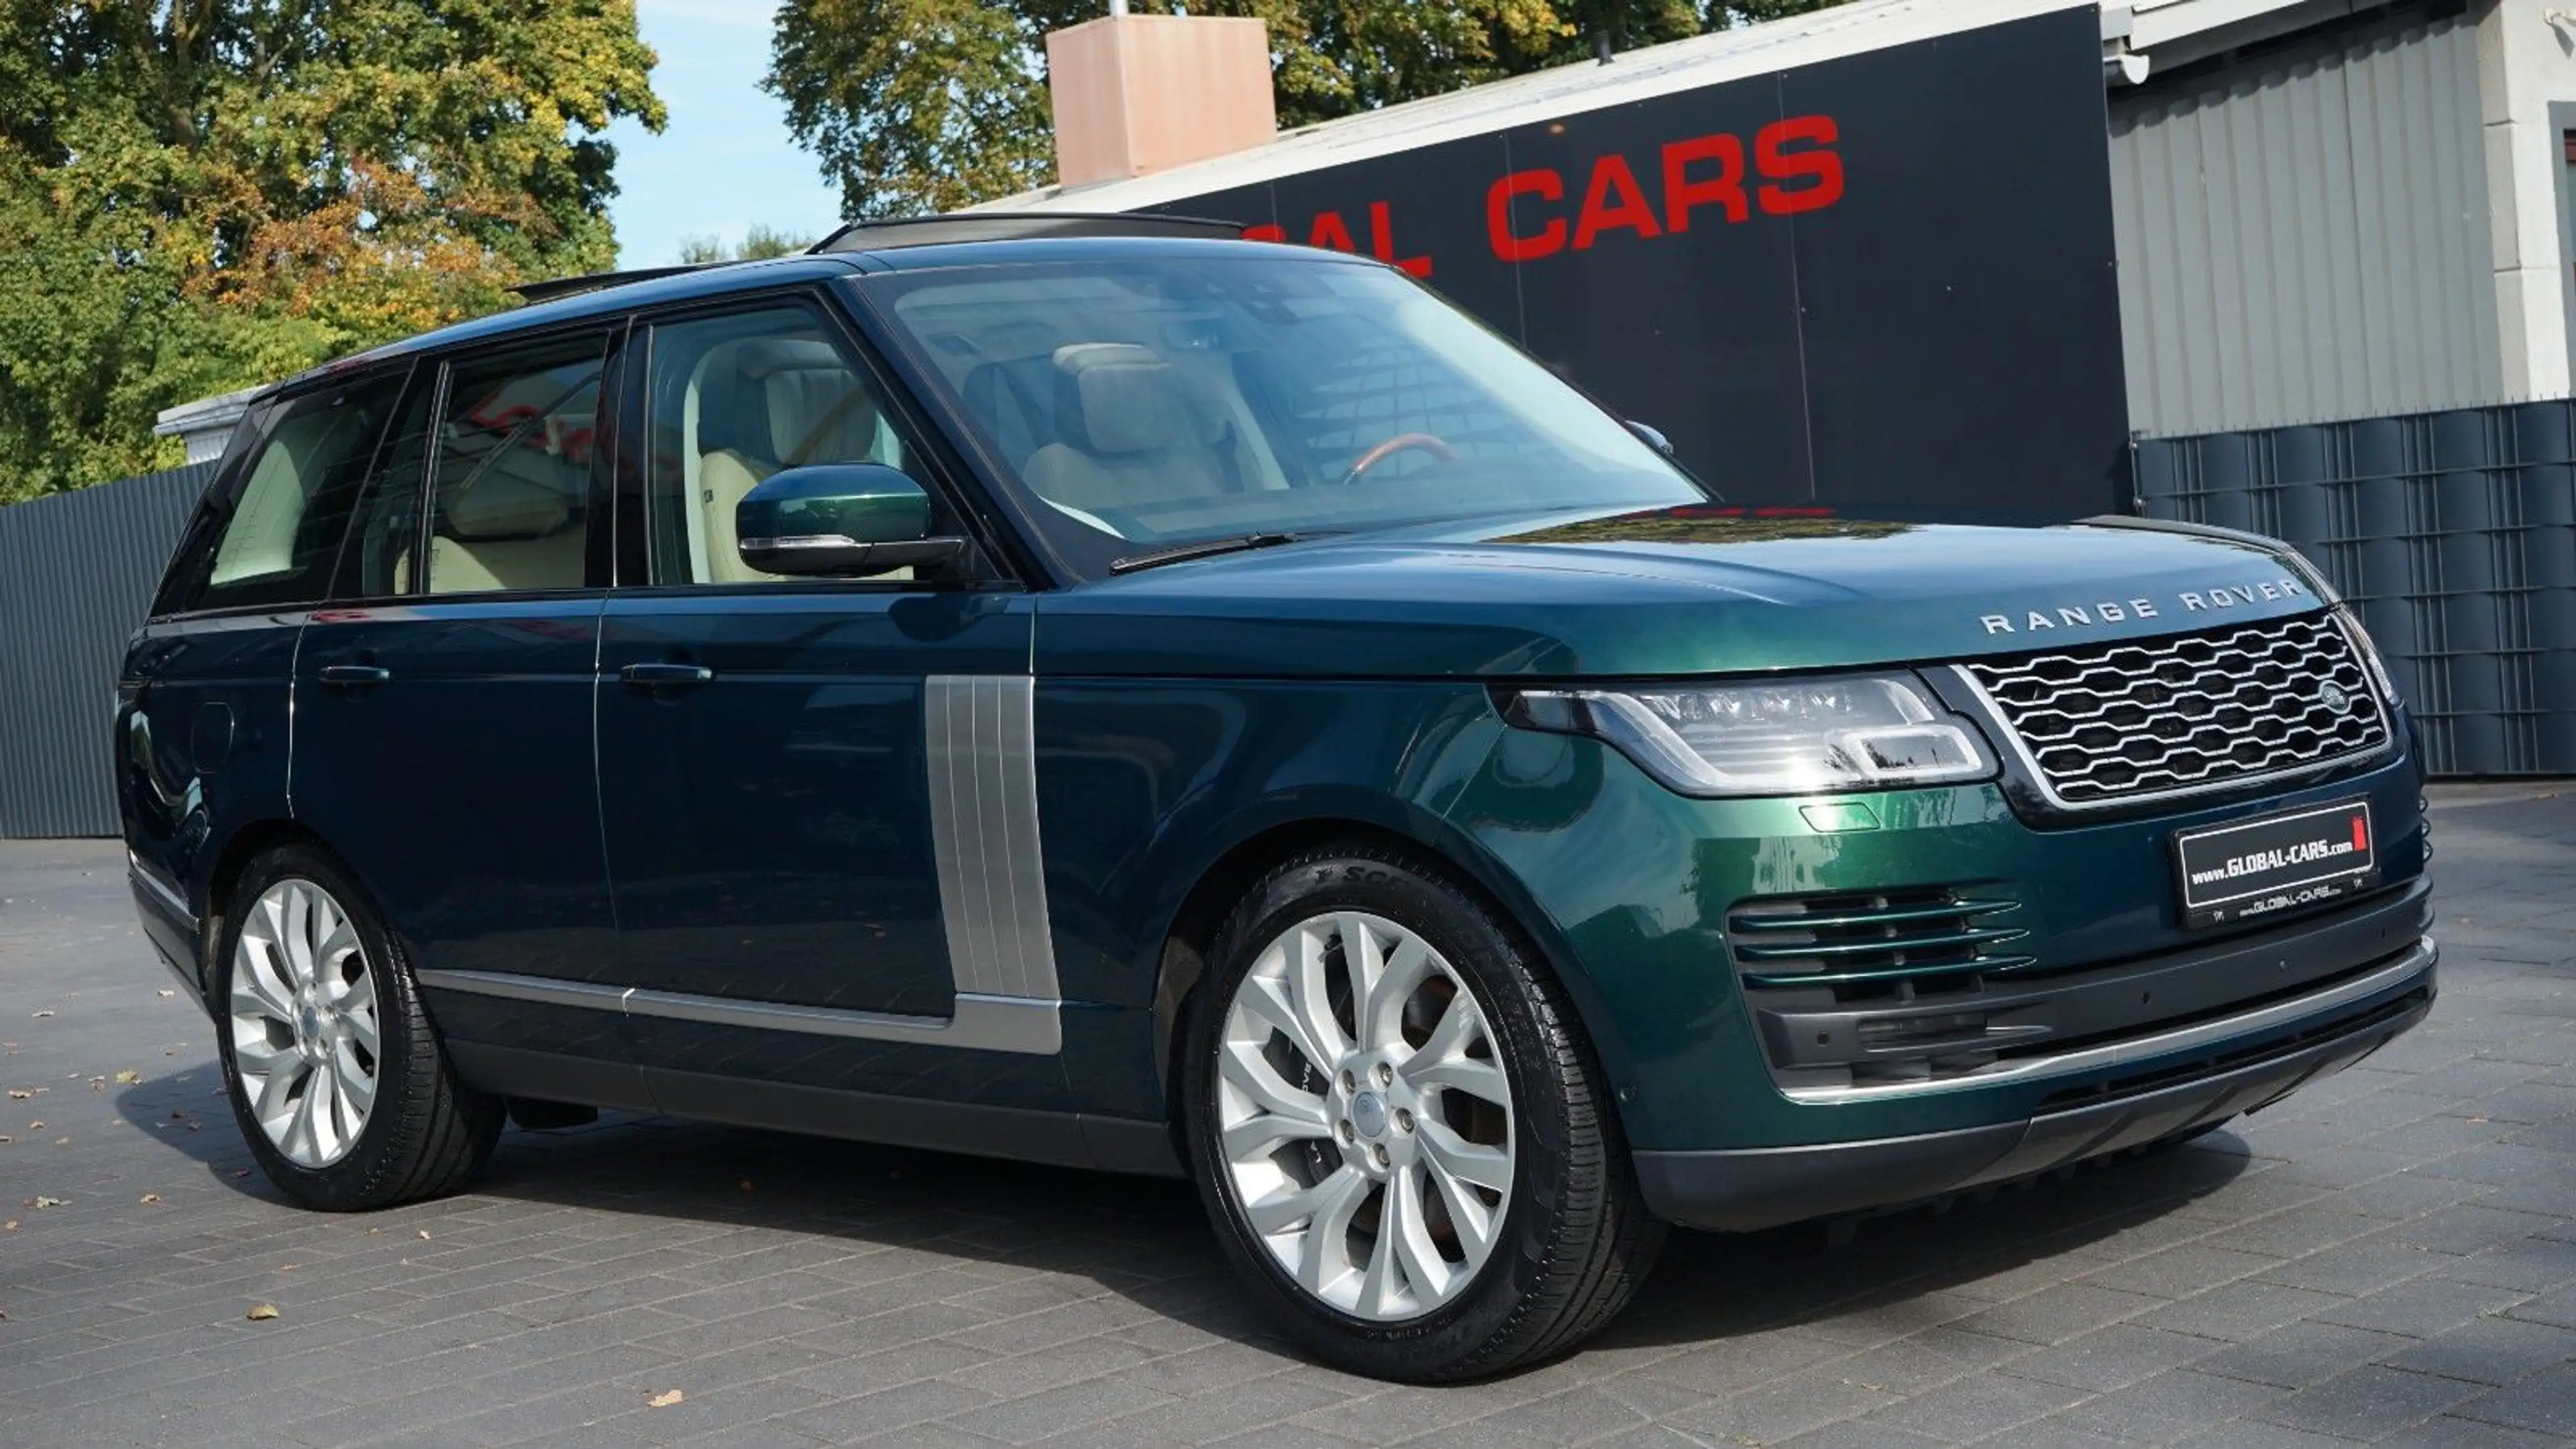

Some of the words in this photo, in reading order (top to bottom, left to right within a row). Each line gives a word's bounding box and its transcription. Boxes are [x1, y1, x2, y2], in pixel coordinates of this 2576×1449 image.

[1486, 114, 1845, 263] CARS
[1980, 598, 2158, 635] RANGE
[2178, 579, 2303, 612] ROVER
[2192, 839, 2353, 885] www.GLOBAL-CARS.com
